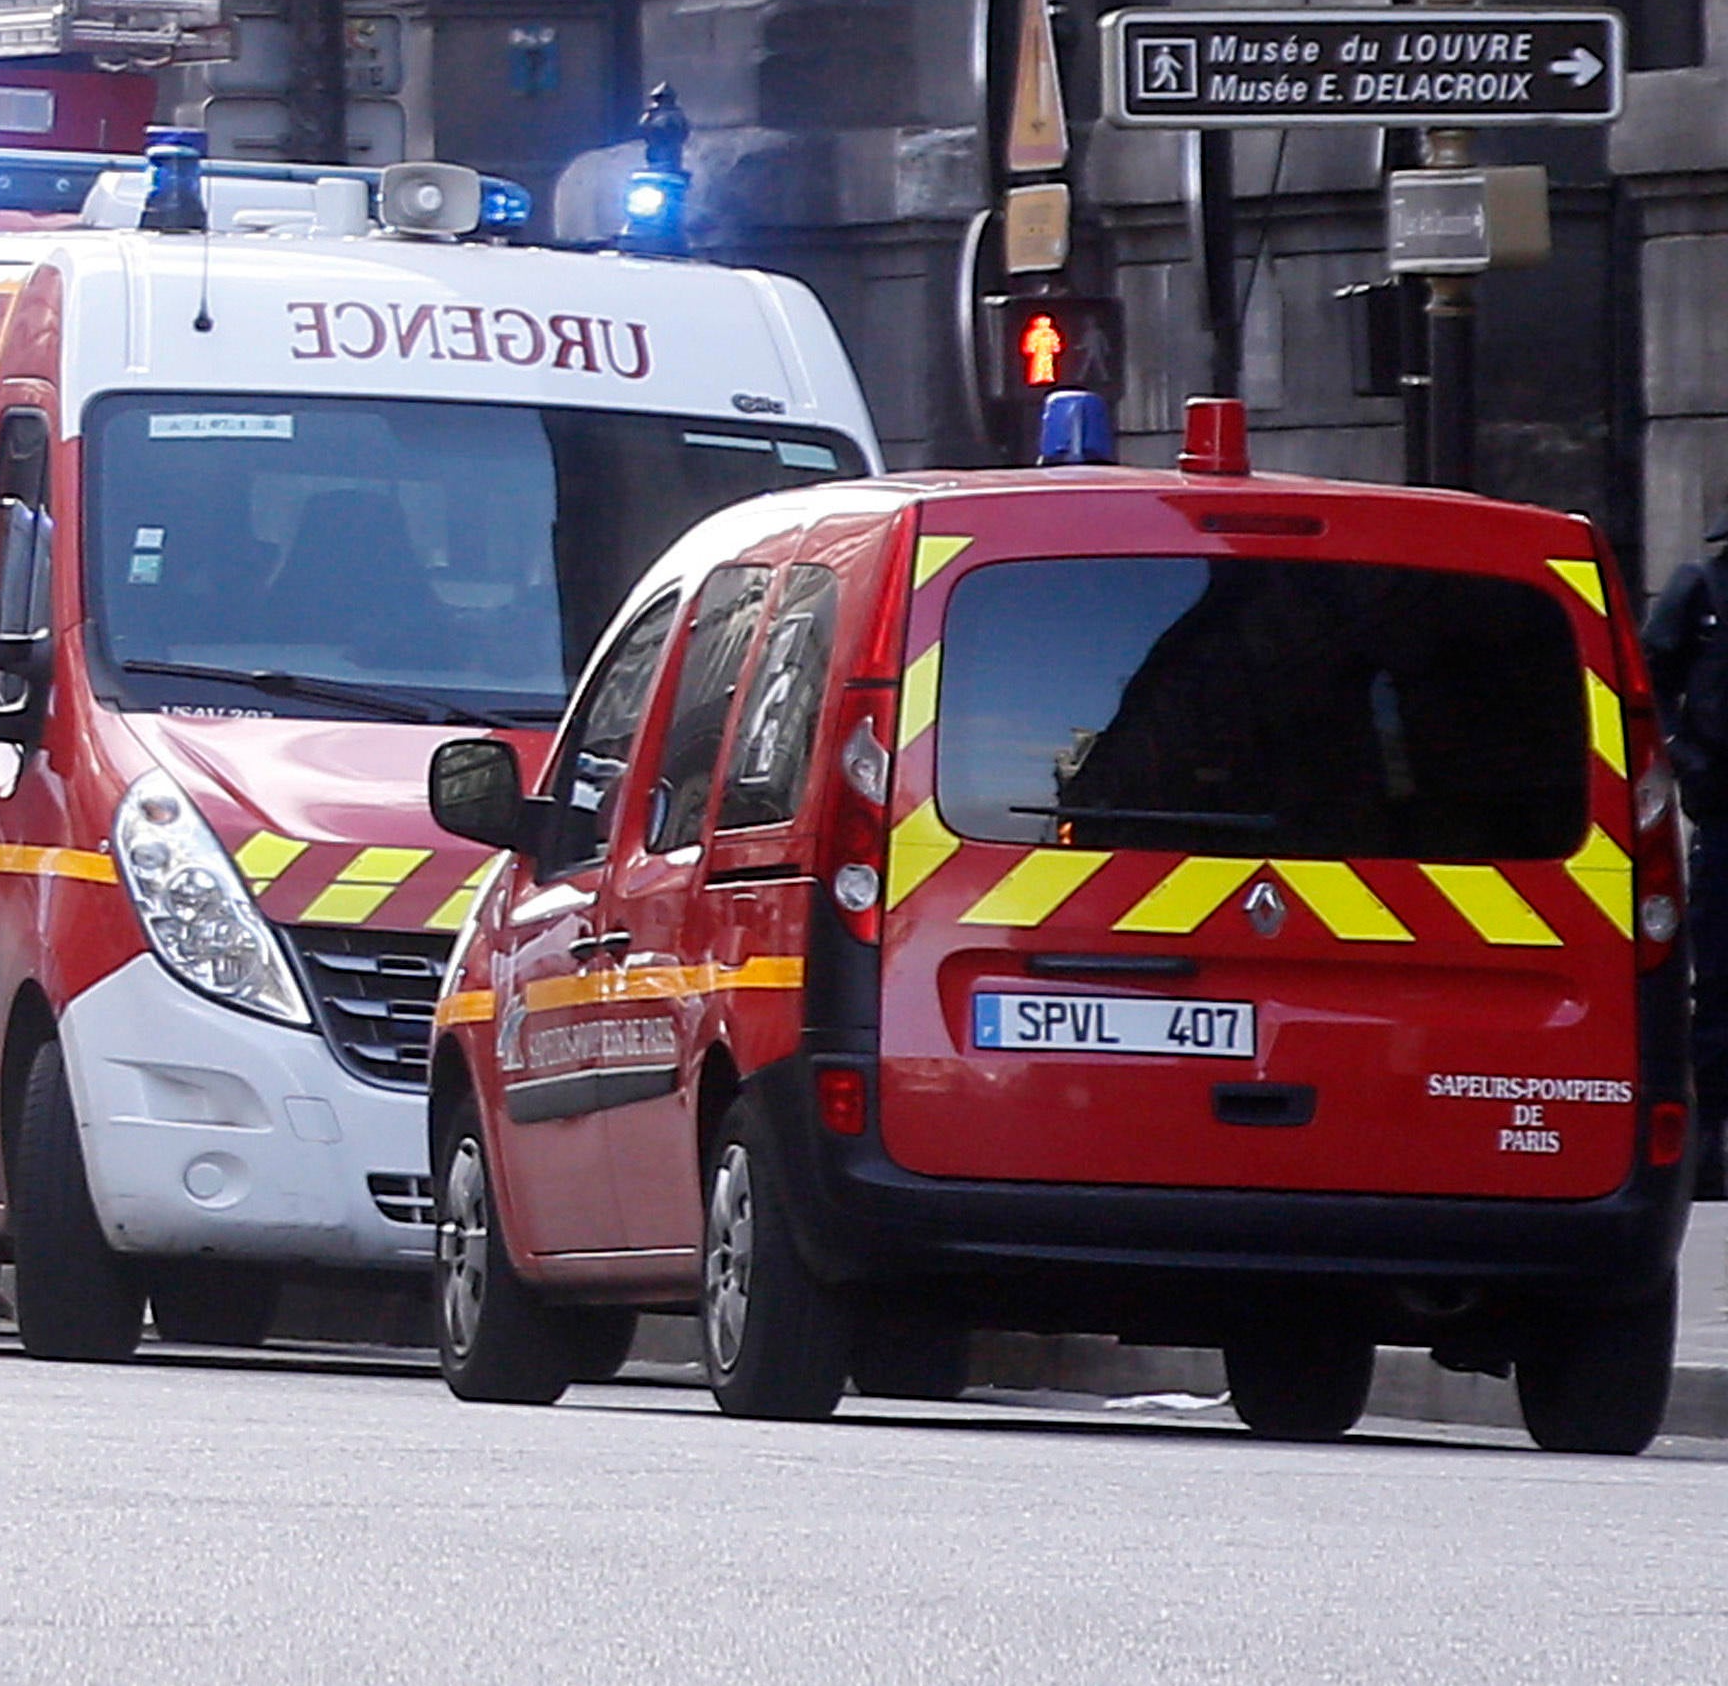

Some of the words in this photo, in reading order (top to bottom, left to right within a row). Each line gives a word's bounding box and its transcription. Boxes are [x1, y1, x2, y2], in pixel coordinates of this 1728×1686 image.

[1209, 33, 1321, 62] Musée
[1341, 33, 1380, 61] du
[1397, 33, 1533, 62] LOUVRE
[1209, 73, 1309, 102] Musée
[1317, 73, 1344, 101] E.
[1353, 73, 1533, 102] DELACROIX
[1017, 1001, 1121, 1045] SPVL
[1166, 1006, 1239, 1049] 407
[1427, 1073, 1633, 1103] SAPEURS-POMPIERS
[1513, 1104, 1545, 1127] DE
[1499, 1129, 1561, 1153] PARIS
